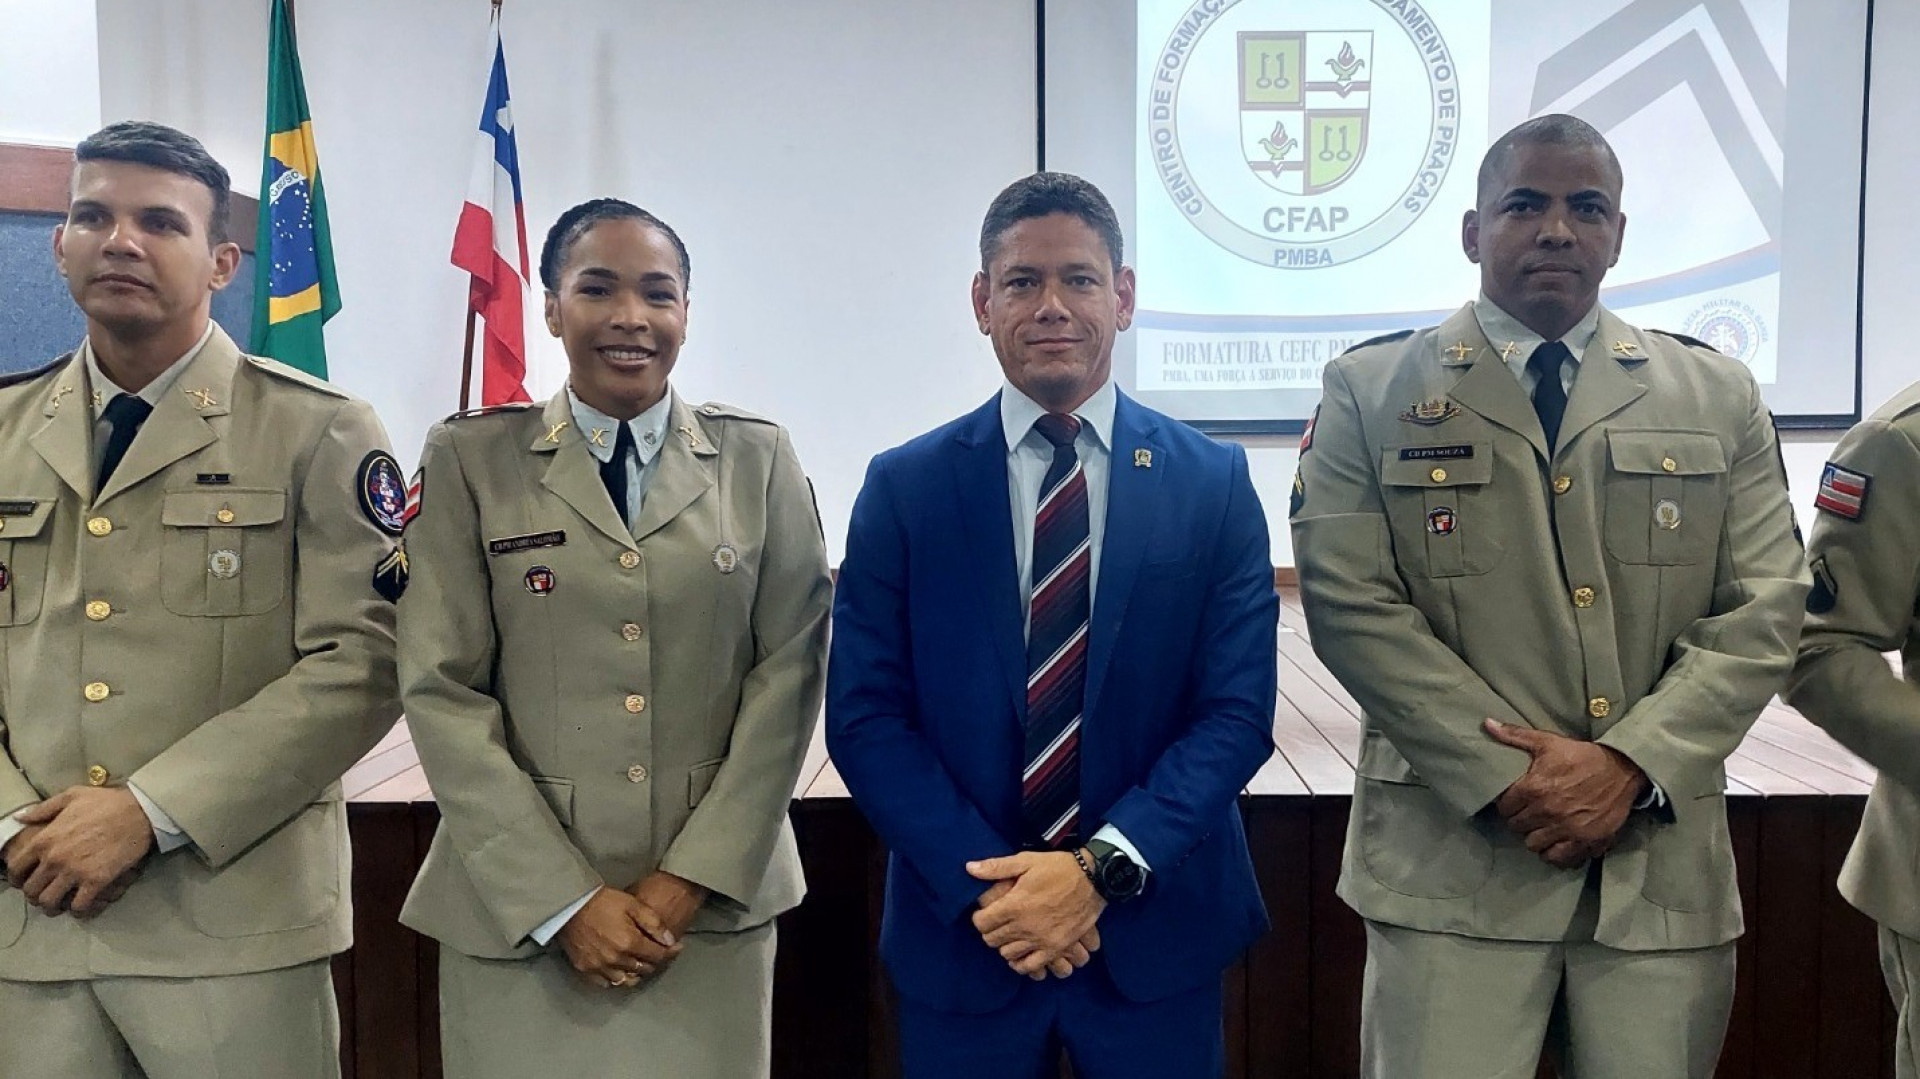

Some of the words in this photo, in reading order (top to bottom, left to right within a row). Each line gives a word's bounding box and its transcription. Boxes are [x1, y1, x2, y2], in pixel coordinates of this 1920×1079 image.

[1158, 0, 1225, 83] FORMAÇ
[1383, 0, 1451, 82] AMENTO
[1153, 89, 1172, 120] DE
[1438, 88, 1455, 119] DE
[1154, 128, 1203, 216] CENTRO
[1404, 125, 1454, 213] PRAÇAS
[1263, 206, 1349, 233] CFAP
[1274, 248, 1333, 266] PMBA
[1162, 341, 1273, 365] FORMATURA
[1279, 339, 1322, 363] CEFC
[1194, 369, 1214, 382] UMA
[1217, 368, 1247, 383] FORÇA
[1259, 367, 1297, 382] SERVIÇO
[1300, 367, 1312, 381] DO
